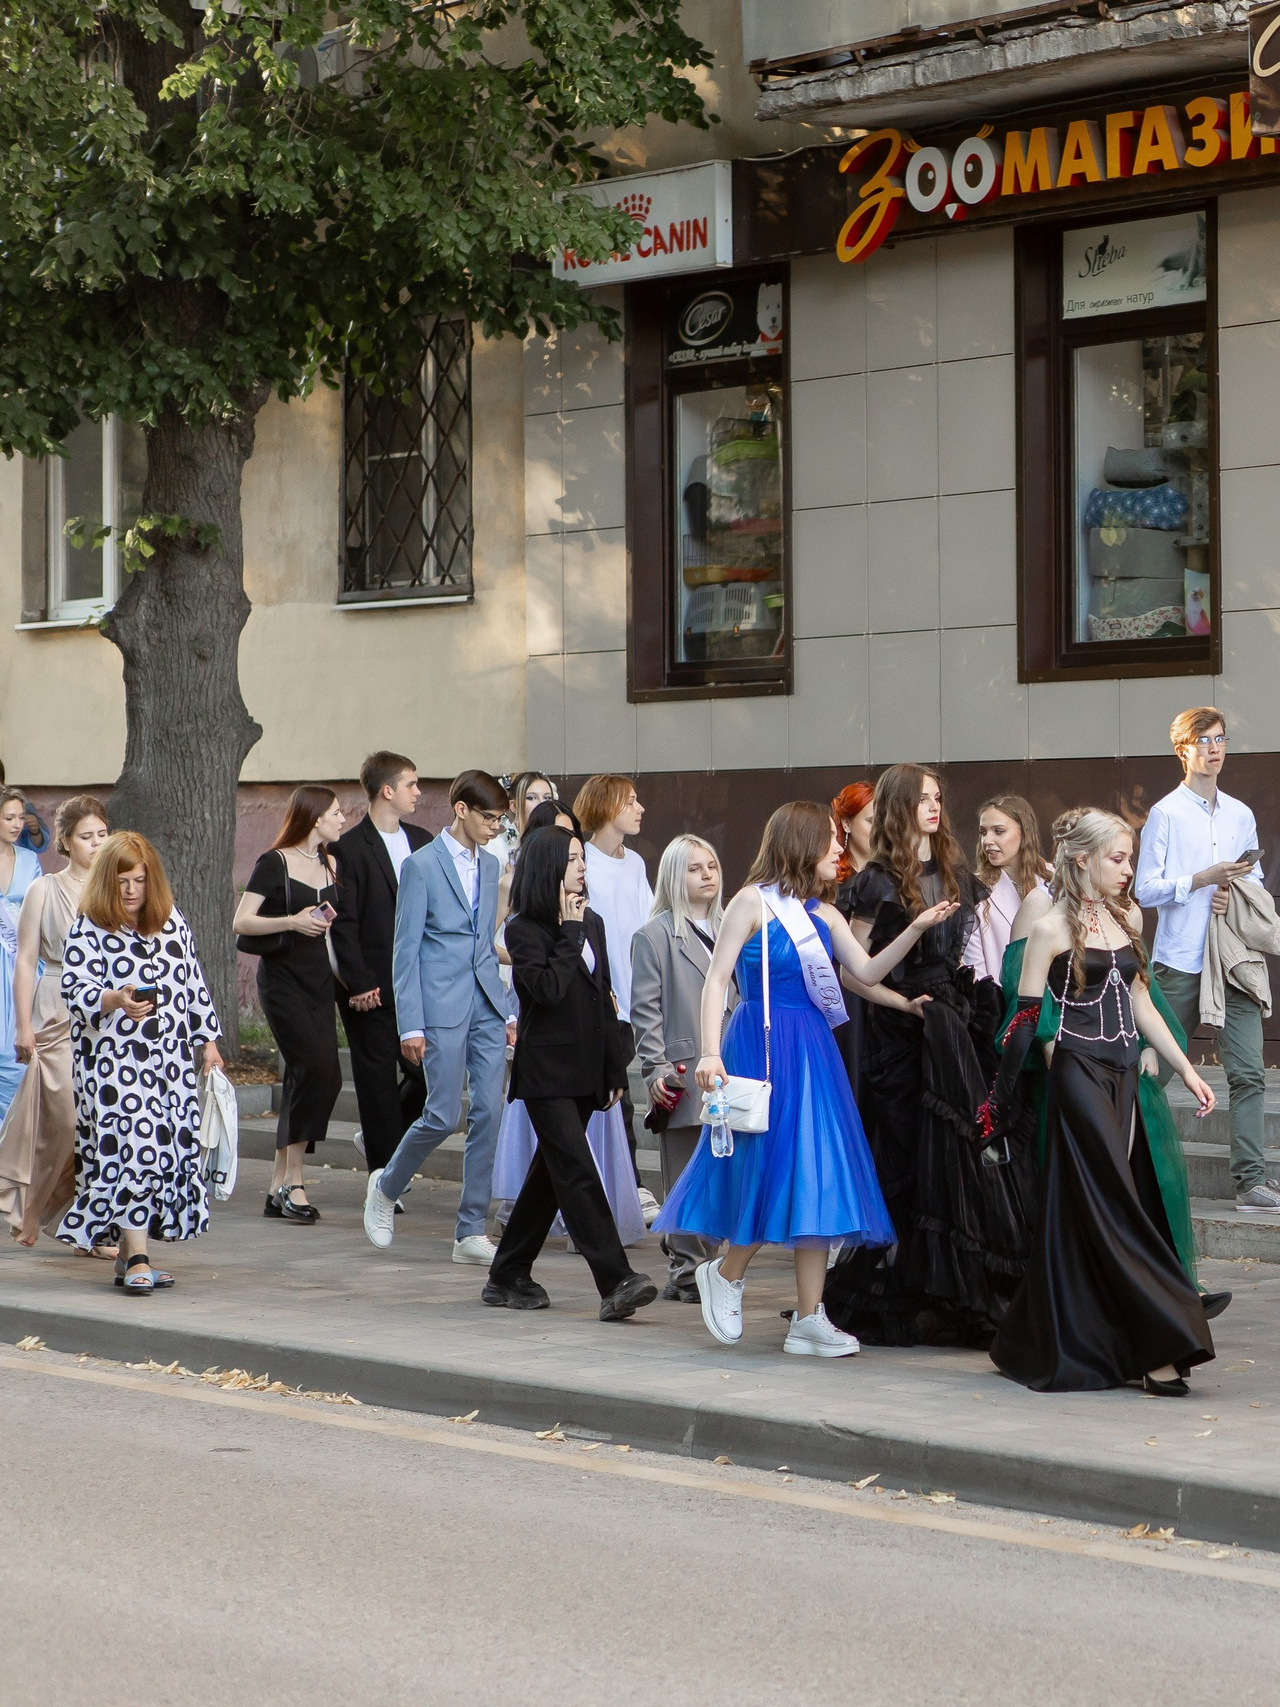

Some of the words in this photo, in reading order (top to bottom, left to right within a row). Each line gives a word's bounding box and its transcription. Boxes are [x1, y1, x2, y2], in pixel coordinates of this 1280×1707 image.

[636, 216, 708, 258] CANIN
[1078, 243, 1126, 279] Sheba
[1066, 299, 1086, 313] Для
[1126, 291, 1155, 305] натур
[685, 304, 727, 337] Cesar
